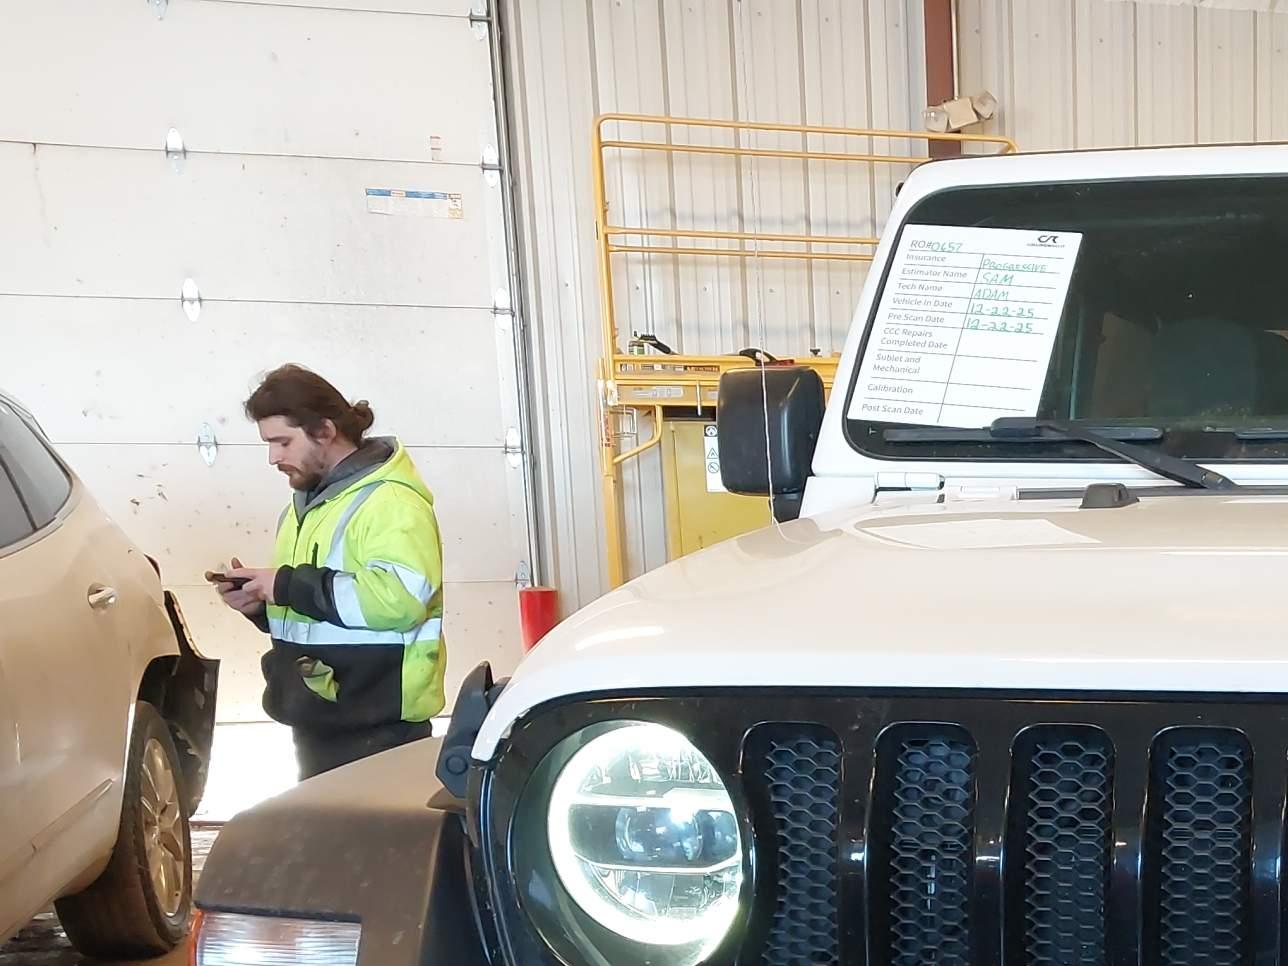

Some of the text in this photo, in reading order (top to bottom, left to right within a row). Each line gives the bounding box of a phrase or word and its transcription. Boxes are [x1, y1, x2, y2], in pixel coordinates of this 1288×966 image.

[906, 253, 947, 262] Insurance
[982, 258, 1048, 273] PROGRESSIVE
[902, 268, 968, 279] Estimator Name
[982, 272, 1015, 286] SAM
[897, 282, 943, 292] Tech Name
[974, 289, 1009, 301] ADAM
[892, 297, 953, 308] Vehicle In Date
[970, 303, 1034, 318] 12-22-25
[888, 312, 945, 324] Pre Scan Date
[966, 318, 1033, 333] 12-22-25
[883, 327, 933, 339] CCC Repairs
[880, 337, 948, 350] Completed Date
[876, 353, 921, 364] Sublet and
[872, 364, 920, 374] Mechanical
[867, 383, 913, 394] Calibration
[862, 403, 924, 415] Post Scan Date
